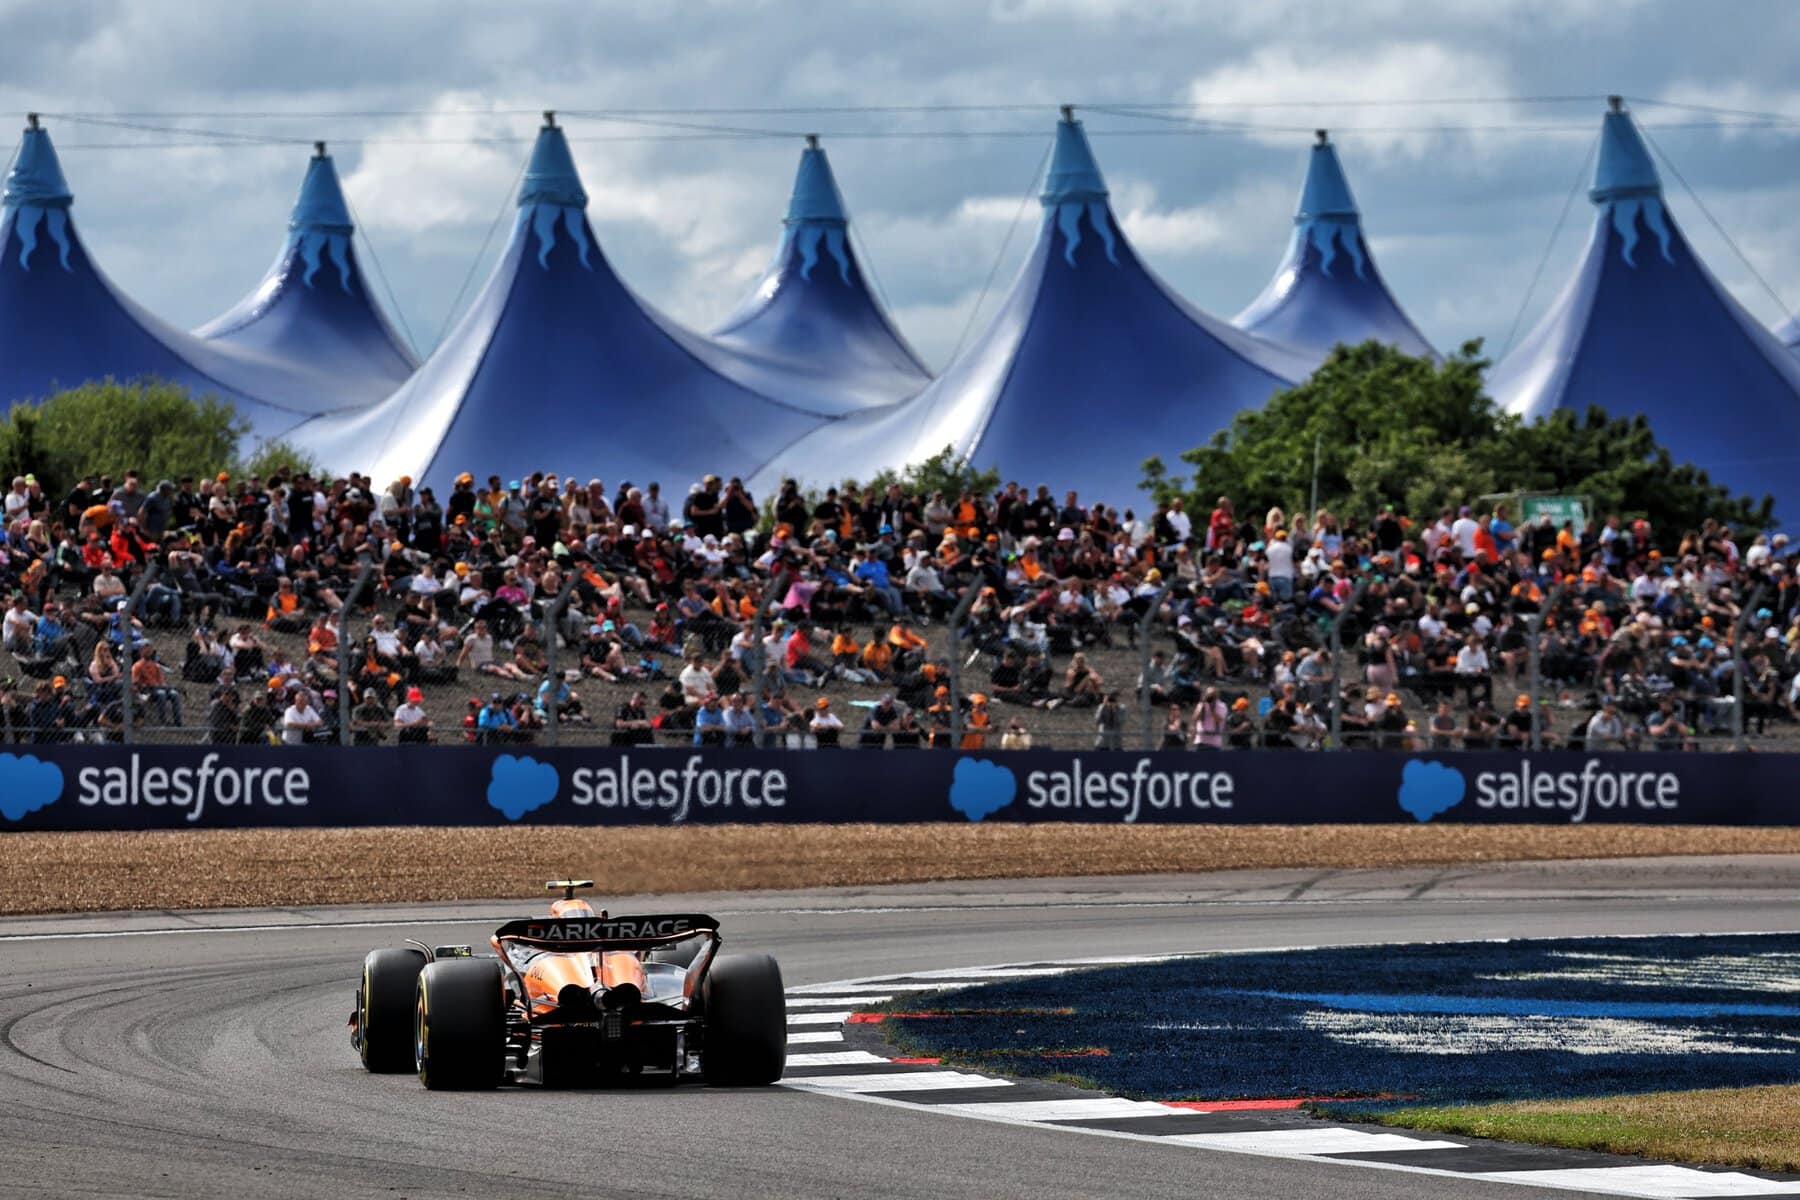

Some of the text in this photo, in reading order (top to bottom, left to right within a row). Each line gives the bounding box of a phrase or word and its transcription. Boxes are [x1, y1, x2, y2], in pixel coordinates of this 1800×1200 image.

[78, 753, 310, 821] salesforce
[571, 755, 786, 821] salesforce
[1027, 759, 1234, 822] salesforce
[1476, 760, 1679, 822] salesforce
[527, 919, 689, 940] DARKTRACE
